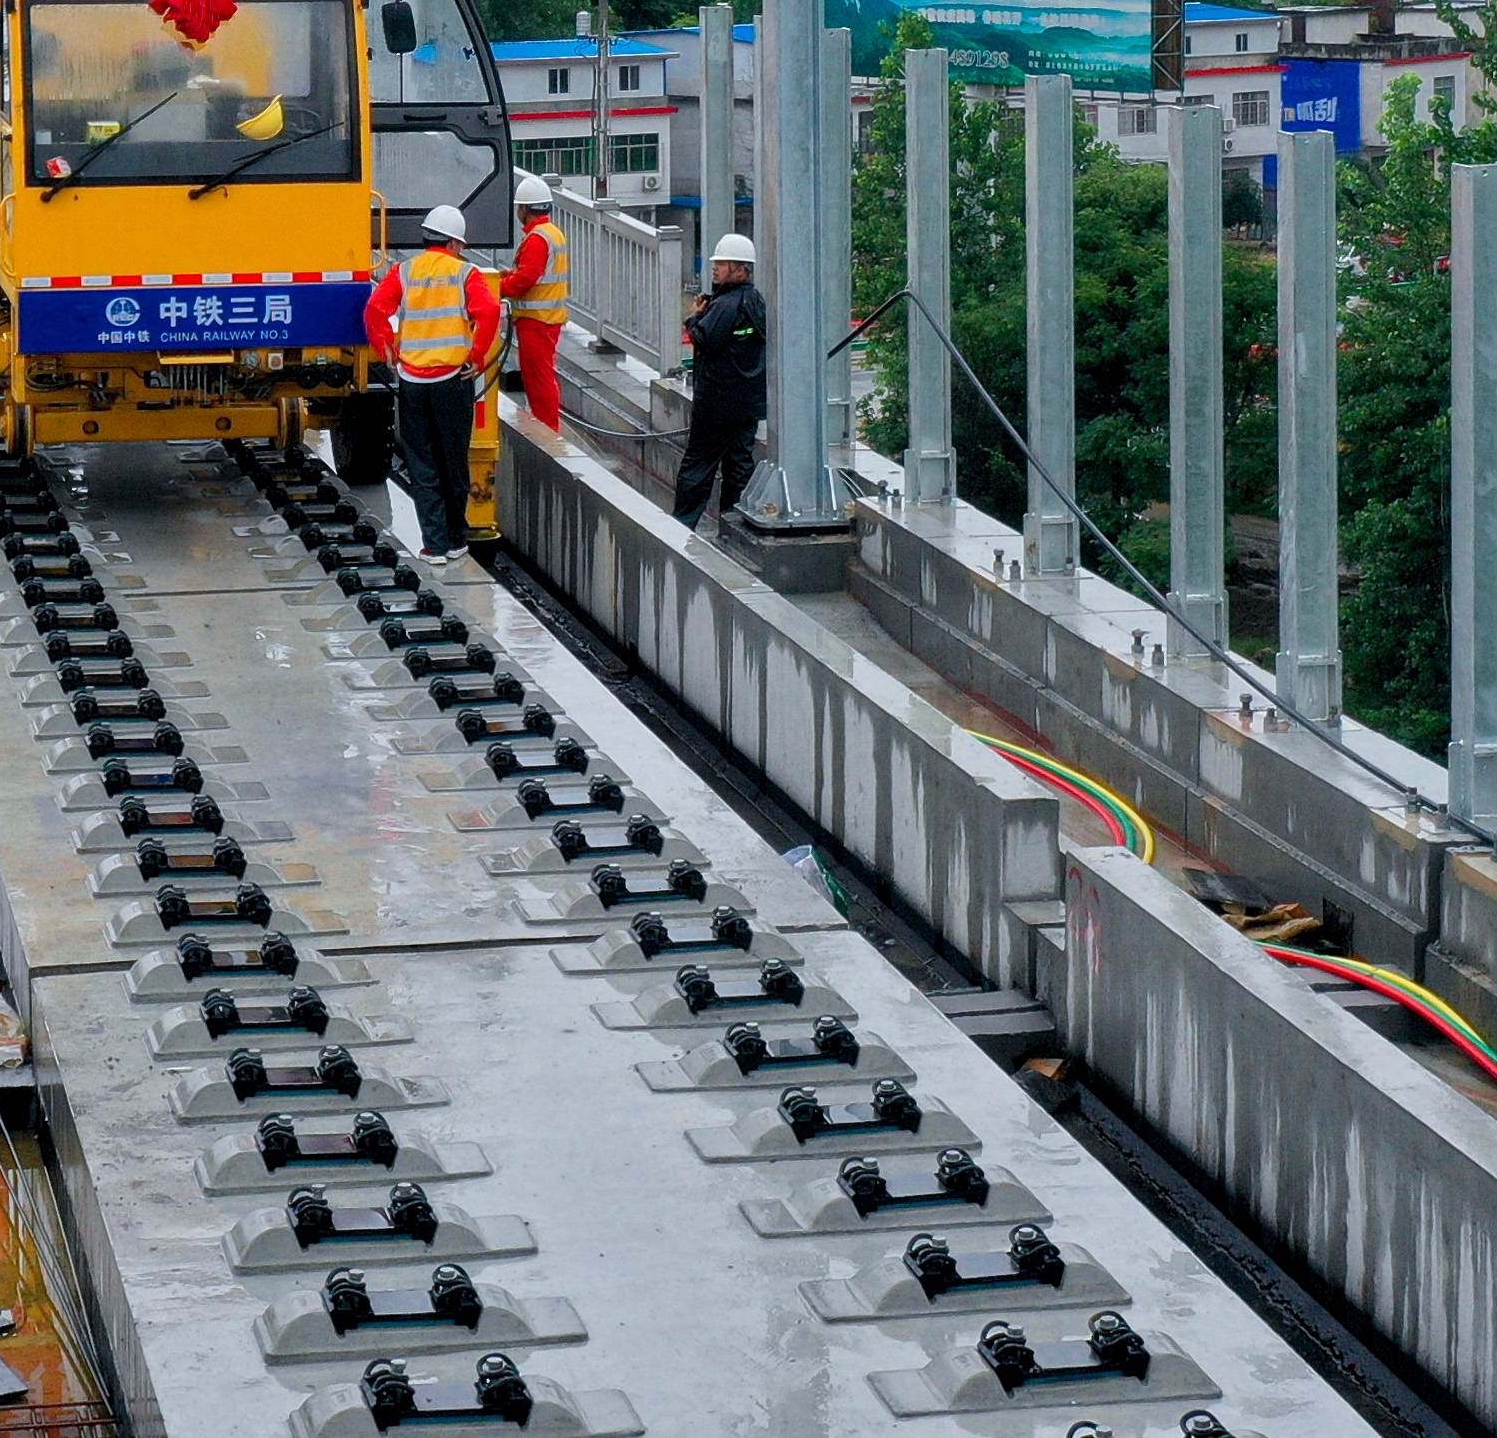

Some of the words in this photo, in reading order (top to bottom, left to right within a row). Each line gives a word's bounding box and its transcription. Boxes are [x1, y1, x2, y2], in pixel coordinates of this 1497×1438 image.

[159, 294, 293, 328] 中铁三局
[97, 330, 151, 345] 中国中铁
[160, 331, 199, 343] CHINA
[203, 330, 255, 342] RAILWAY
[260, 329, 290, 341] NO.3
